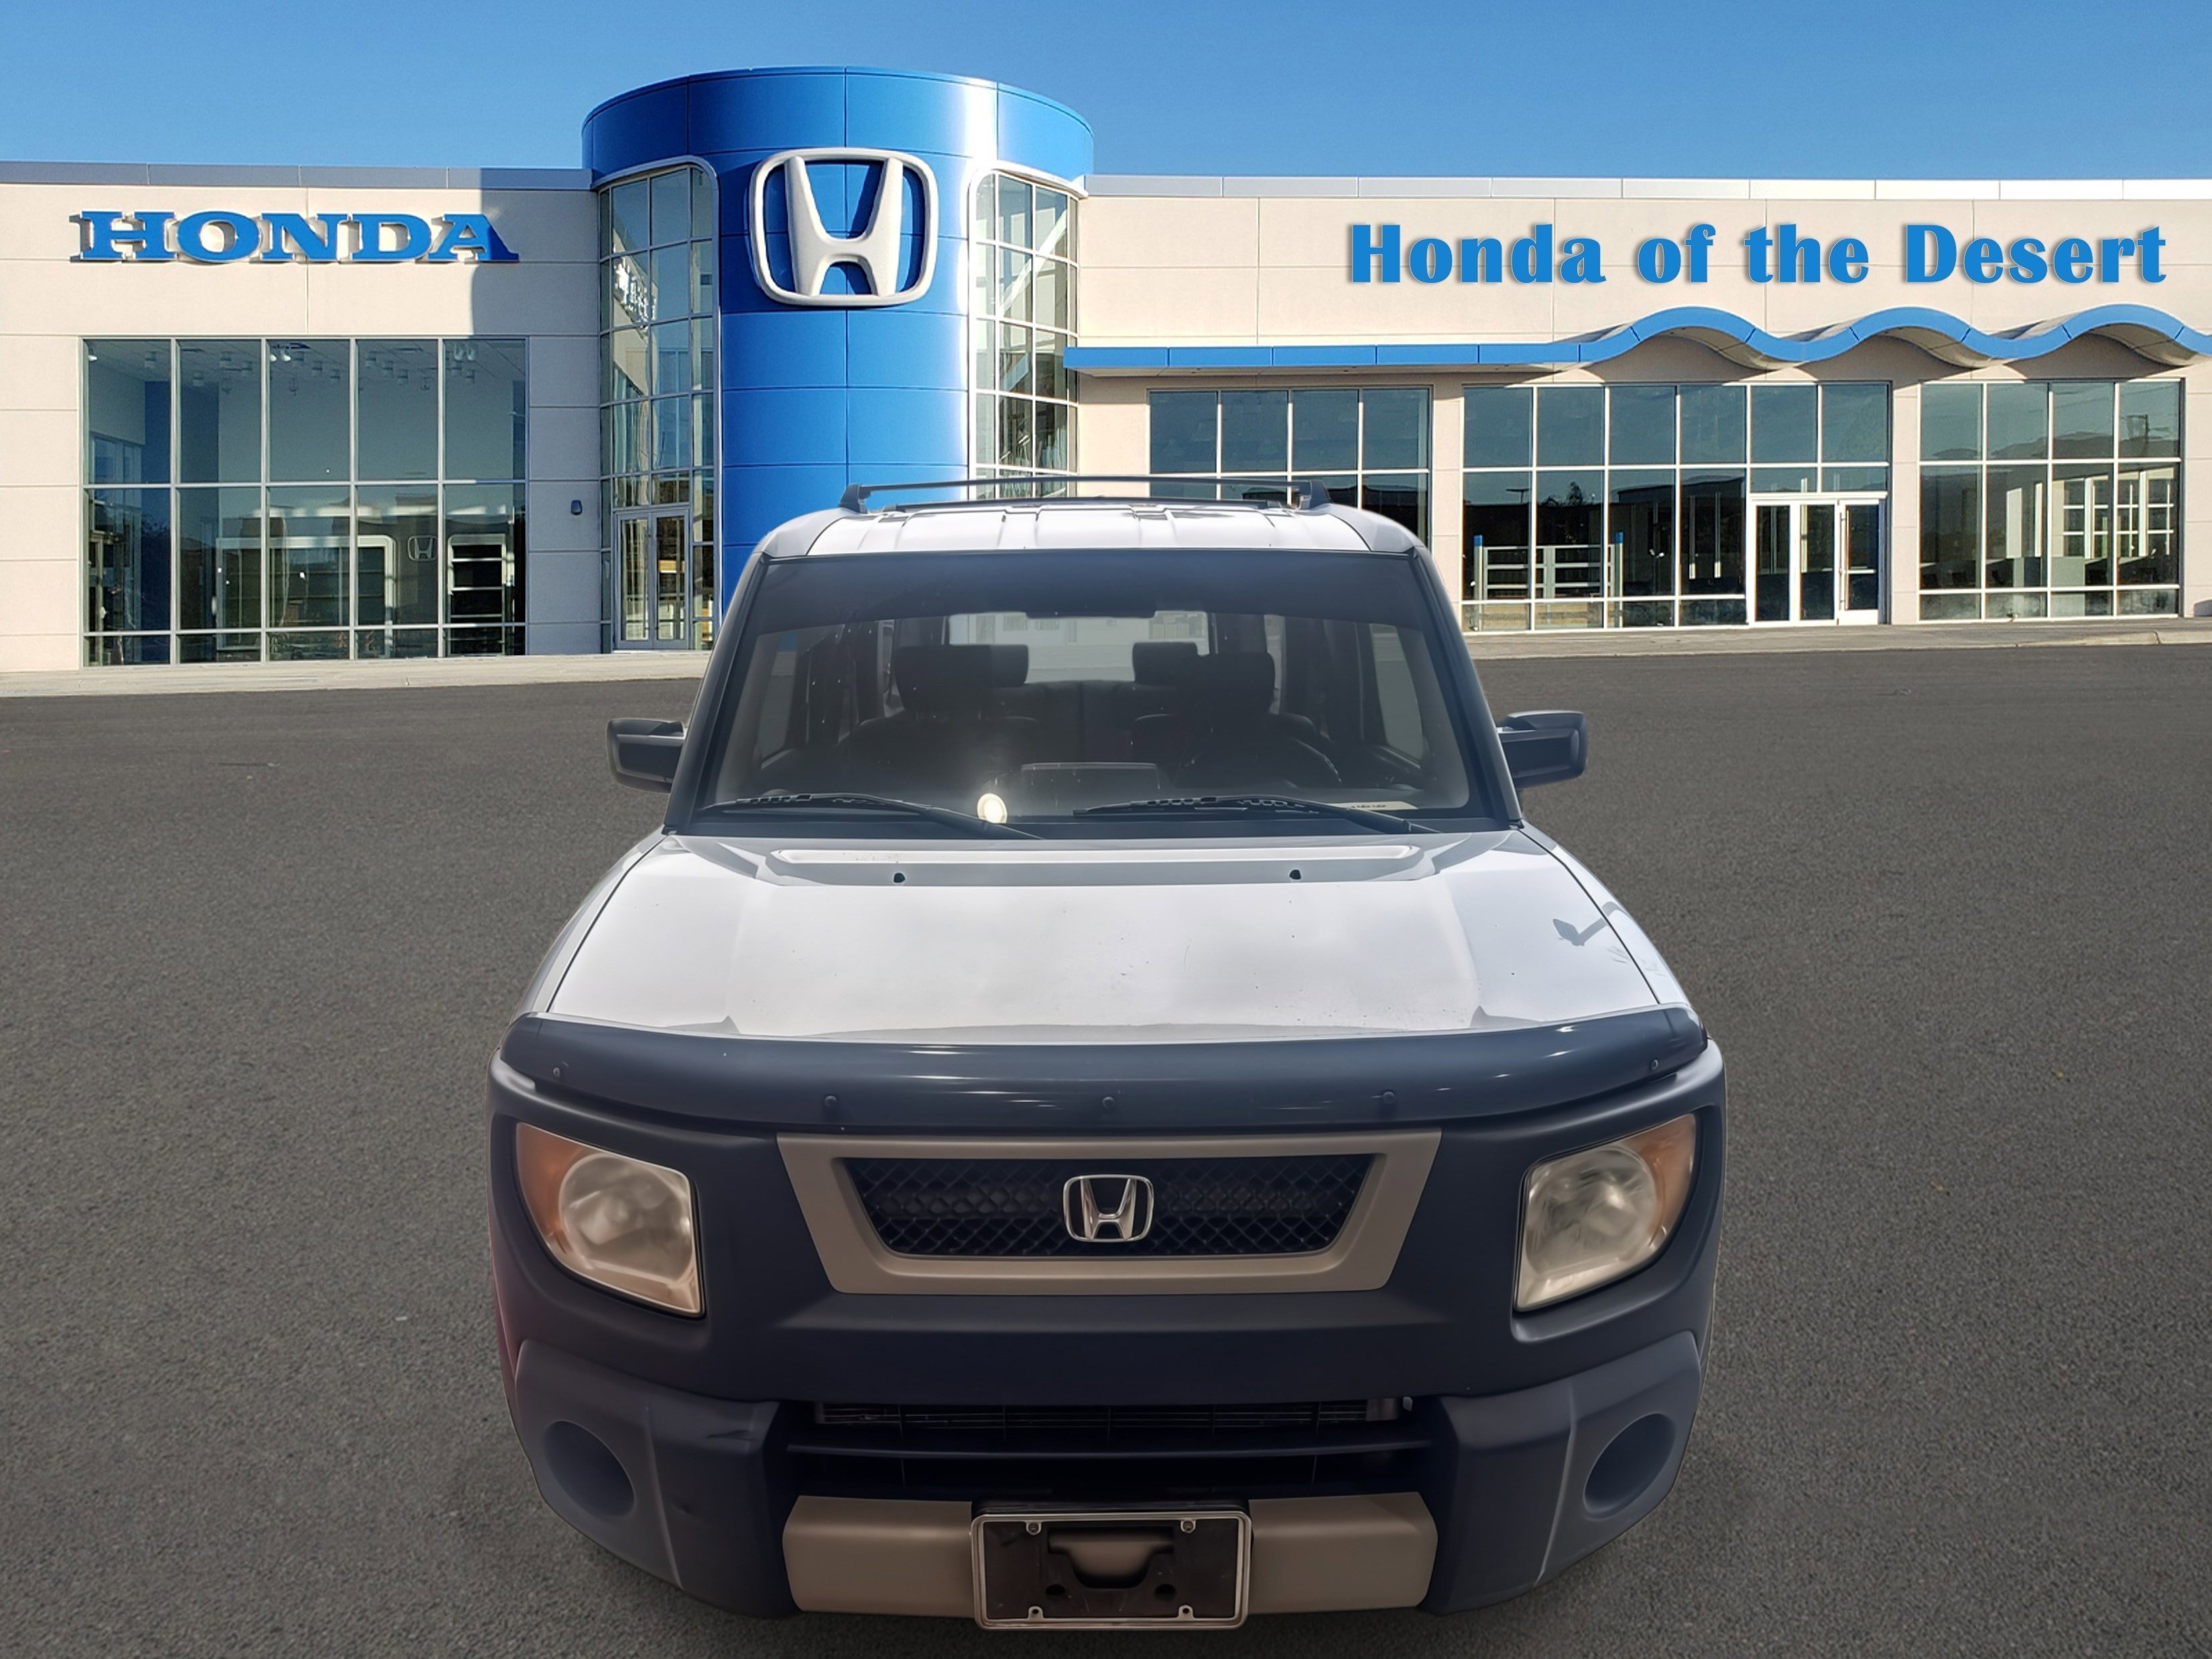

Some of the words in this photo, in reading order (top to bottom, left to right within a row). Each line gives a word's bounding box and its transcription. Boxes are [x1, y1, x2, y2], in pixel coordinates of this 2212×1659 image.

[80, 210, 519, 262] HONDA
[1351, 223, 1607, 284] Honda
[1637, 223, 1717, 284] of
[1743, 224, 1869, 284] the
[1905, 224, 2167, 284] Desert
